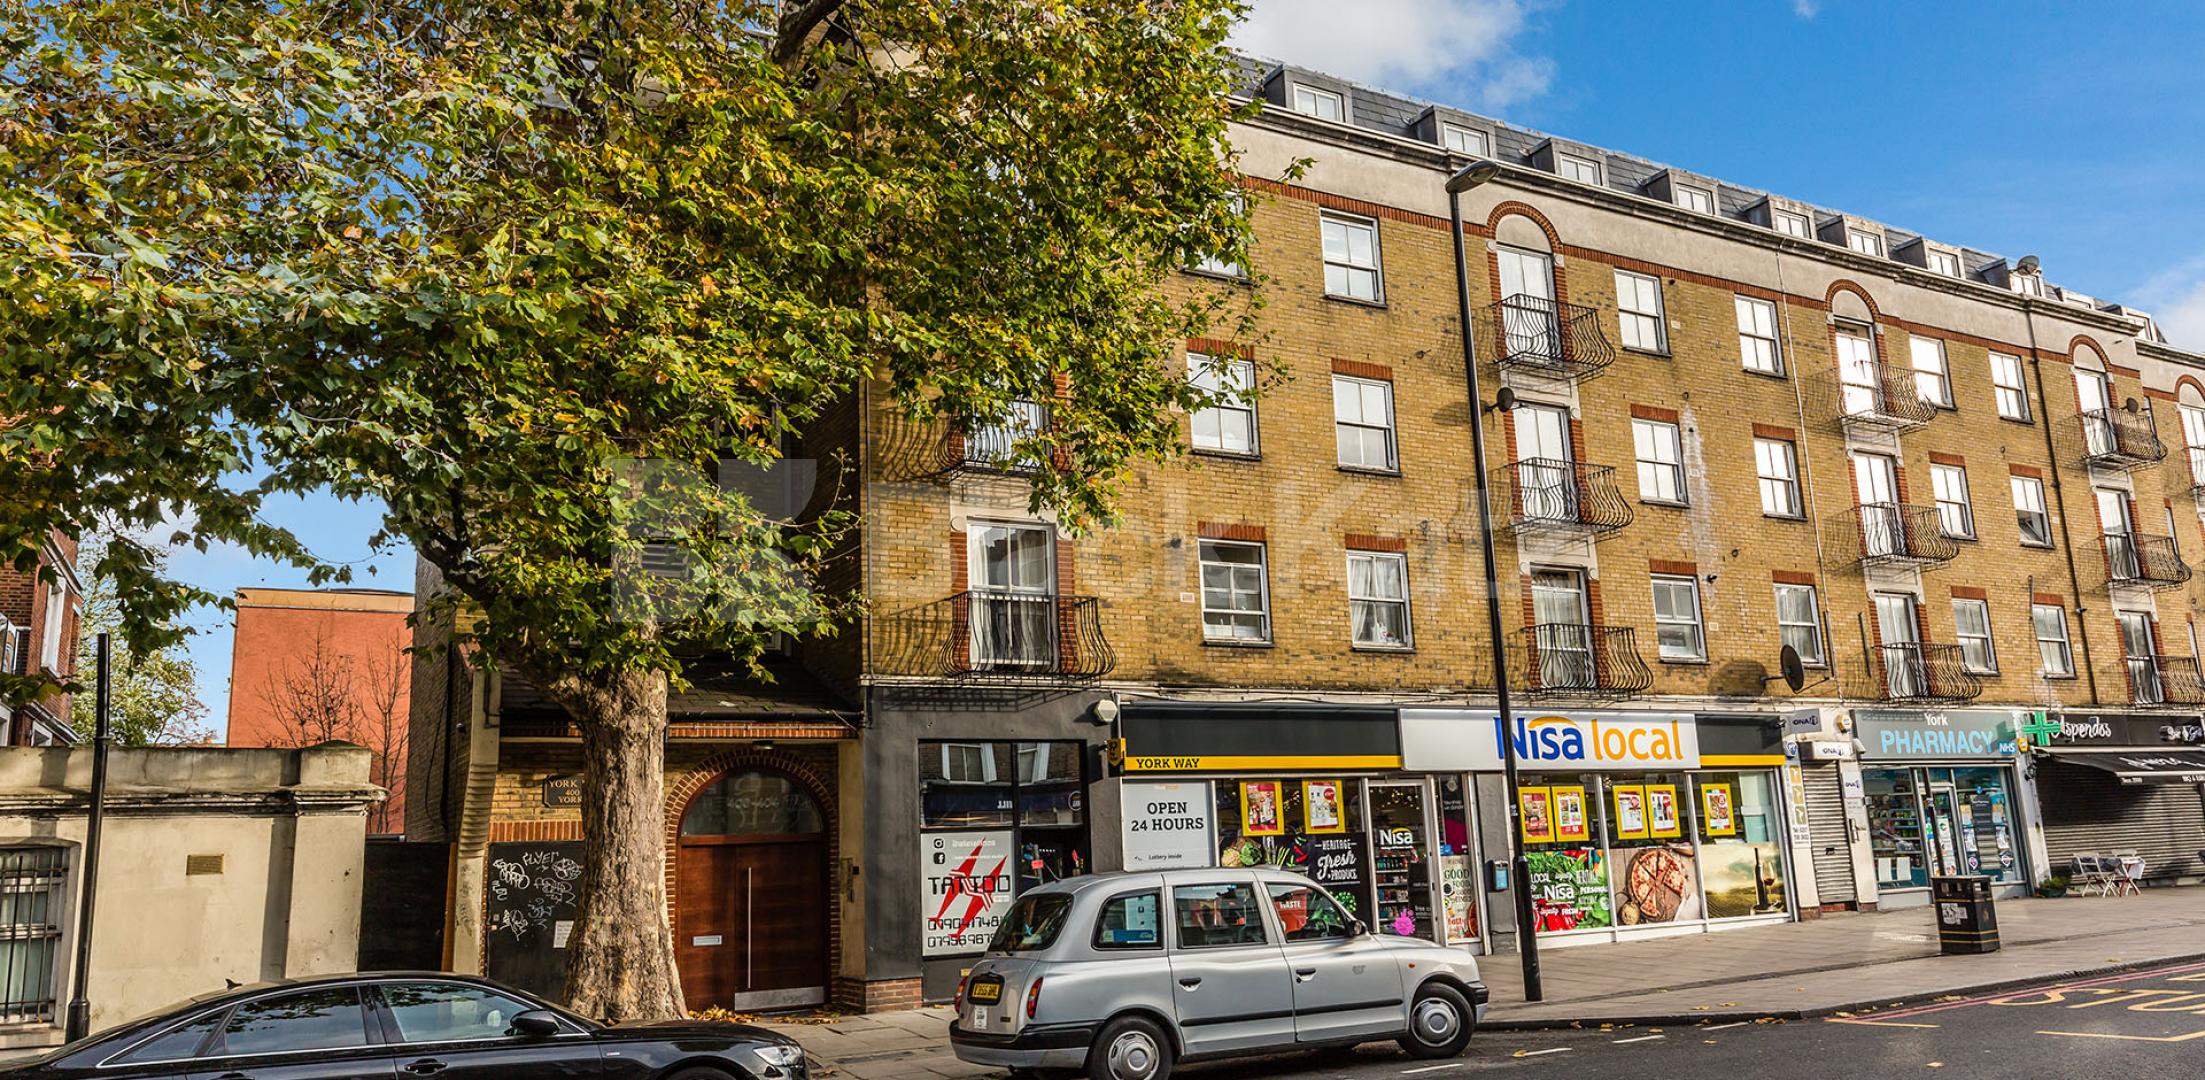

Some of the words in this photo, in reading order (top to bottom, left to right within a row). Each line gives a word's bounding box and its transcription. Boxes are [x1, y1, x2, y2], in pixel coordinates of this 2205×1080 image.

[1924, 712, 1948, 726] York
[1493, 716, 1585, 760] Nisa
[1591, 718, 1683, 761] local
[1880, 729, 1994, 754] PHARMACY
[2000, 743, 2016, 753] NHS
[1137, 759, 1170, 768] YORK
[1174, 758, 1200, 768] WAY
[549, 780, 578, 788] YORK
[1147, 802, 1187, 814] OPEN
[1131, 820, 1148, 831] 24
[1152, 818, 1204, 831] HOURS
[1379, 828, 1413, 845] Nisa
[1316, 850, 1357, 880] Fresh
[1444, 869, 1470, 879] GOOD
[928, 875, 1010, 895] TATTOO
[1544, 883, 1575, 901] Nisa
